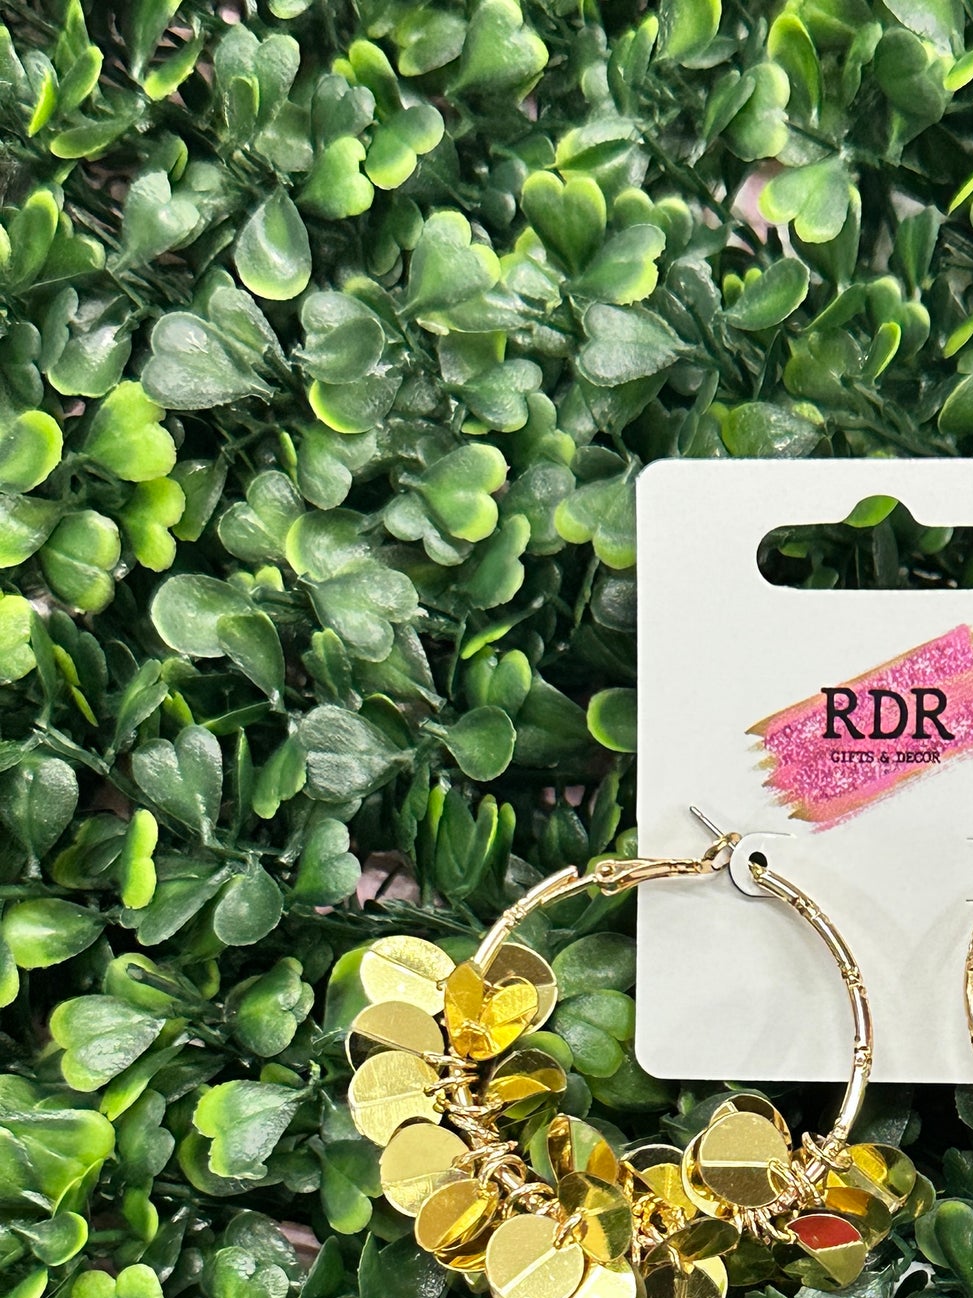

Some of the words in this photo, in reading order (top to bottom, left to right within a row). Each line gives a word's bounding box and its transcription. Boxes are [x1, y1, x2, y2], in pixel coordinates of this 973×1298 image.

[820, 687, 956, 741] RDR
[830, 750, 875, 764] GIFTS
[879, 750, 890, 764] &
[895, 750, 941, 764] DECOR
